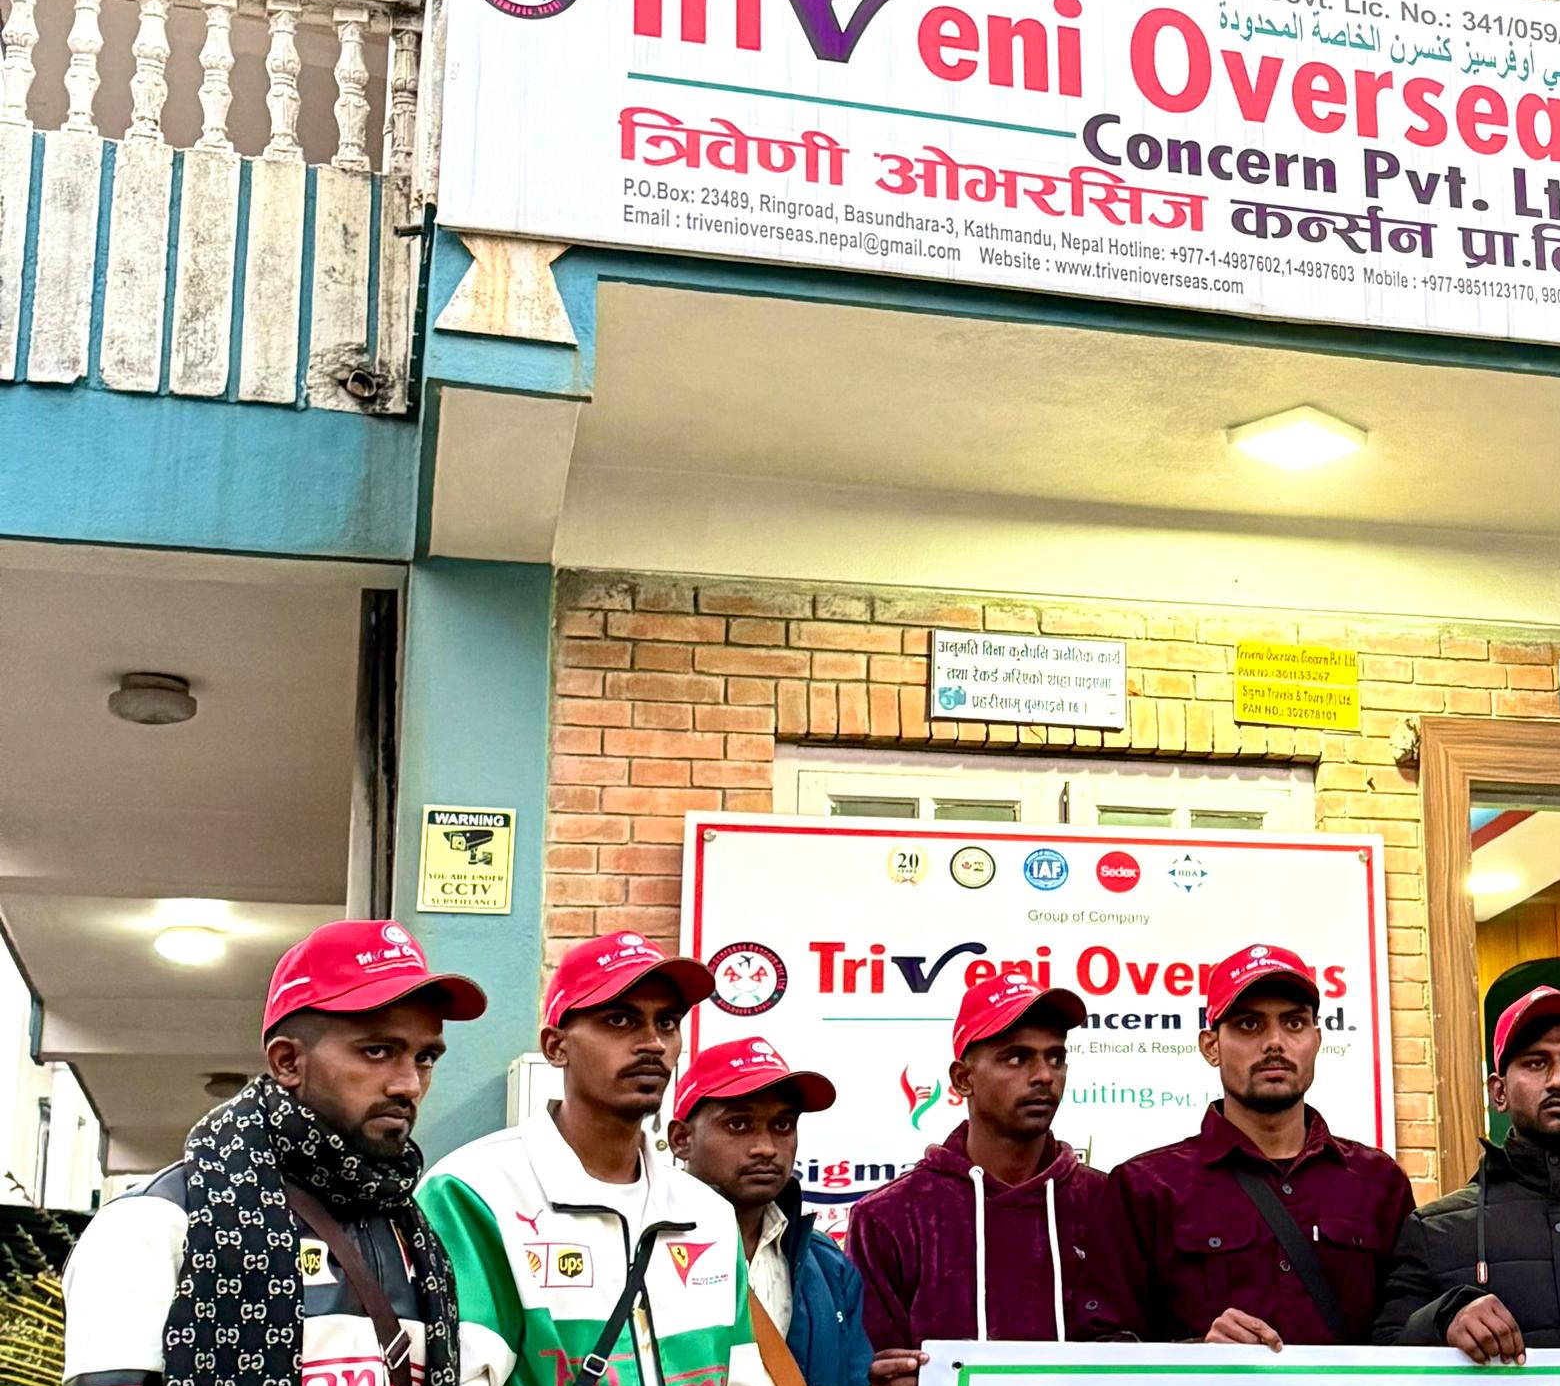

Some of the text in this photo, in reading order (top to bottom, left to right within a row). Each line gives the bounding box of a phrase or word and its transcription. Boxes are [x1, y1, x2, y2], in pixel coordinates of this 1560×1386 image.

[1218, 0, 1303, 41] المحدودة
[1400, 1, 1450, 27] No.:
[1312, 12, 1380, 52] الخاصة
[618, 107, 850, 185] त्रिवेणी
[875, 145, 1209, 232] ओभरसिज
[1083, 113, 1336, 193] Concern
[1364, 148, 1489, 212] Pvt.
[623, 177, 694, 203] P.O.Box:
[700, 186, 753, 213] 23489,
[759, 193, 838, 223] Ringroad,
[844, 204, 958, 238] Basundhara-3,
[964, 218, 1056, 251] Kathmandu,
[1061, 231, 1103, 255] Nepal
[1108, 237, 1164, 260] Hotline:
[1363, 266, 1408, 288] Mobile
[1420, 274, 1537, 304] +977-9851123170,
[623, 203, 1243, 294] Email trivenioverseas.nepal@gmail.com Website www.trivenioverseas.com
[435, 813, 504, 826] WARNING
[897, 853, 919, 869] 20
[1031, 861, 1061, 879] IAF
[441, 883, 491, 895] CCTV
[1028, 909, 1150, 925] Group of Company
[1077, 945, 1347, 999] Overs
[558, 1255, 584, 1275] ups
